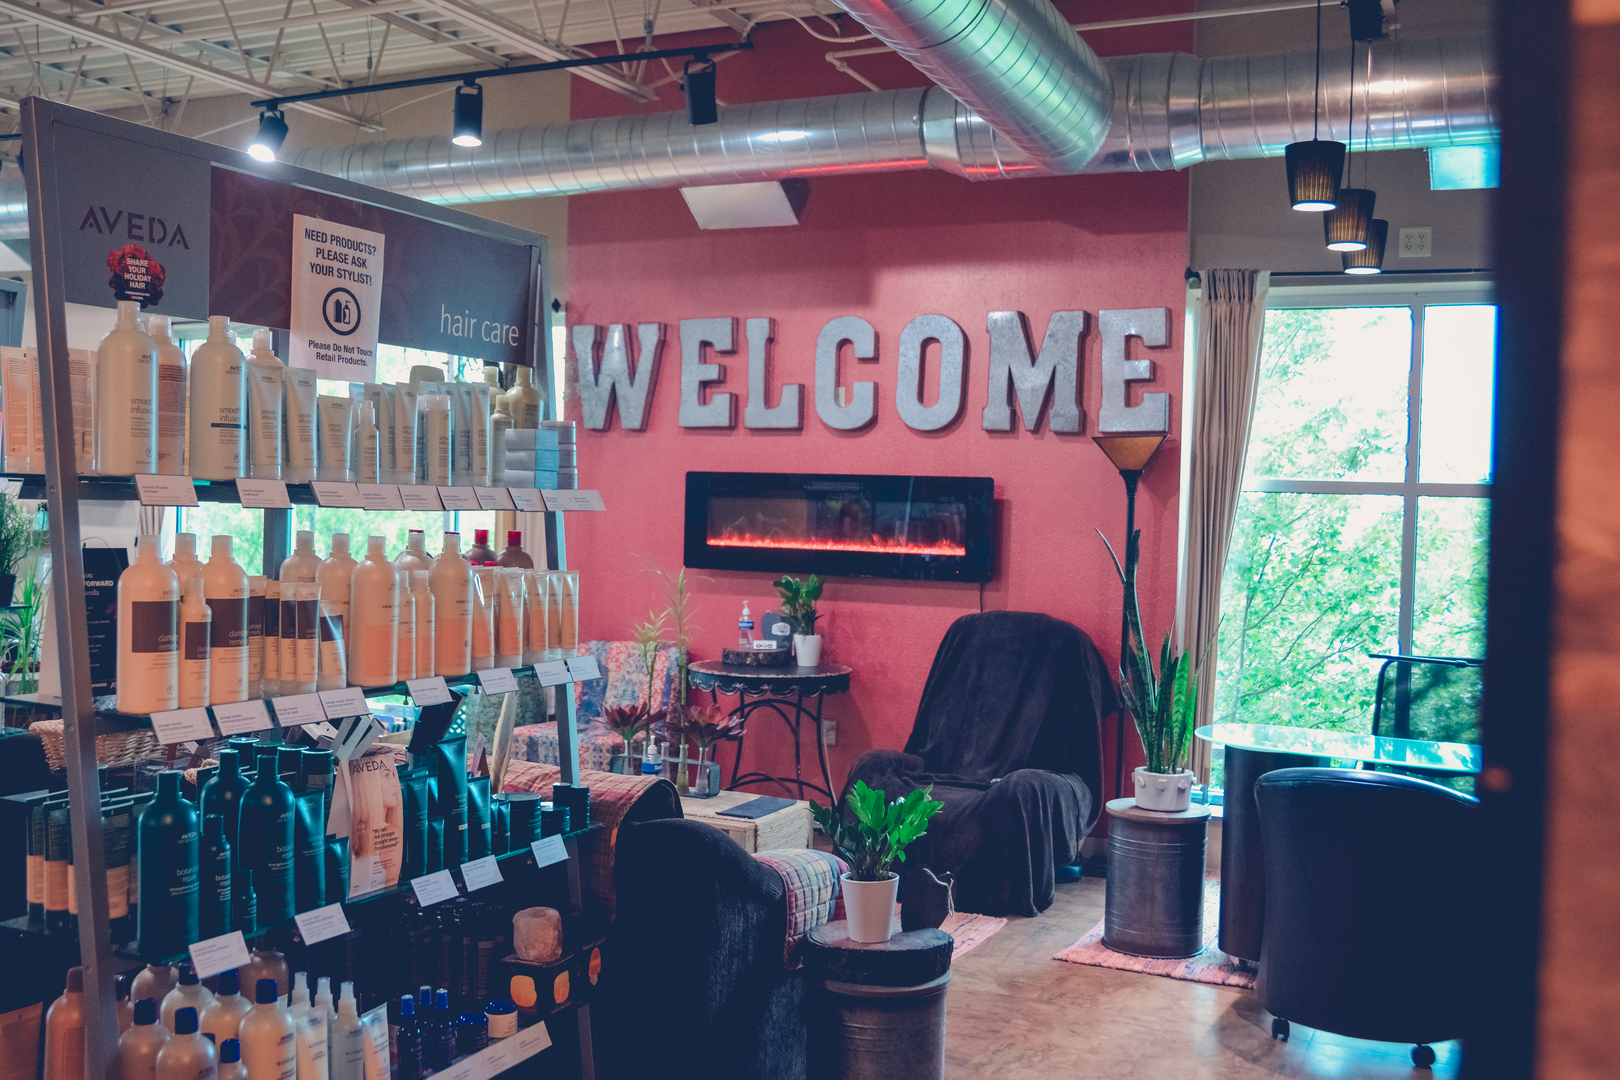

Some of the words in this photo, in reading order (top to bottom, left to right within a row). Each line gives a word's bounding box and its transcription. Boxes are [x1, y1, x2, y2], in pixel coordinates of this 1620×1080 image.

[79, 205, 189, 250] AVEDA
[305, 228, 327, 243] NEED
[330, 234, 376, 256] PRODUCTS?
[126, 258, 148, 267] SHARE
[316, 248, 348, 264] PLEASE
[351, 258, 368, 269] ASK
[124, 272, 152, 283] HOLIDAY
[128, 266, 146, 274] YOUR
[310, 262, 334, 277] YOUR
[337, 268, 372, 286] STYLIST!
[130, 280, 146, 290] HAIR
[440, 304, 476, 338] hair
[482, 320, 519, 346] care
[308, 340, 332, 351] Please
[333, 344, 341, 352] Do
[344, 344, 355, 354] Not
[357, 347, 373, 357] Touch
[316, 352, 336, 362] Retail
[338, 356, 368, 366] Products.
[572, 306, 1171, 434] WELCOME
[352, 760, 387, 774] AVEDA
